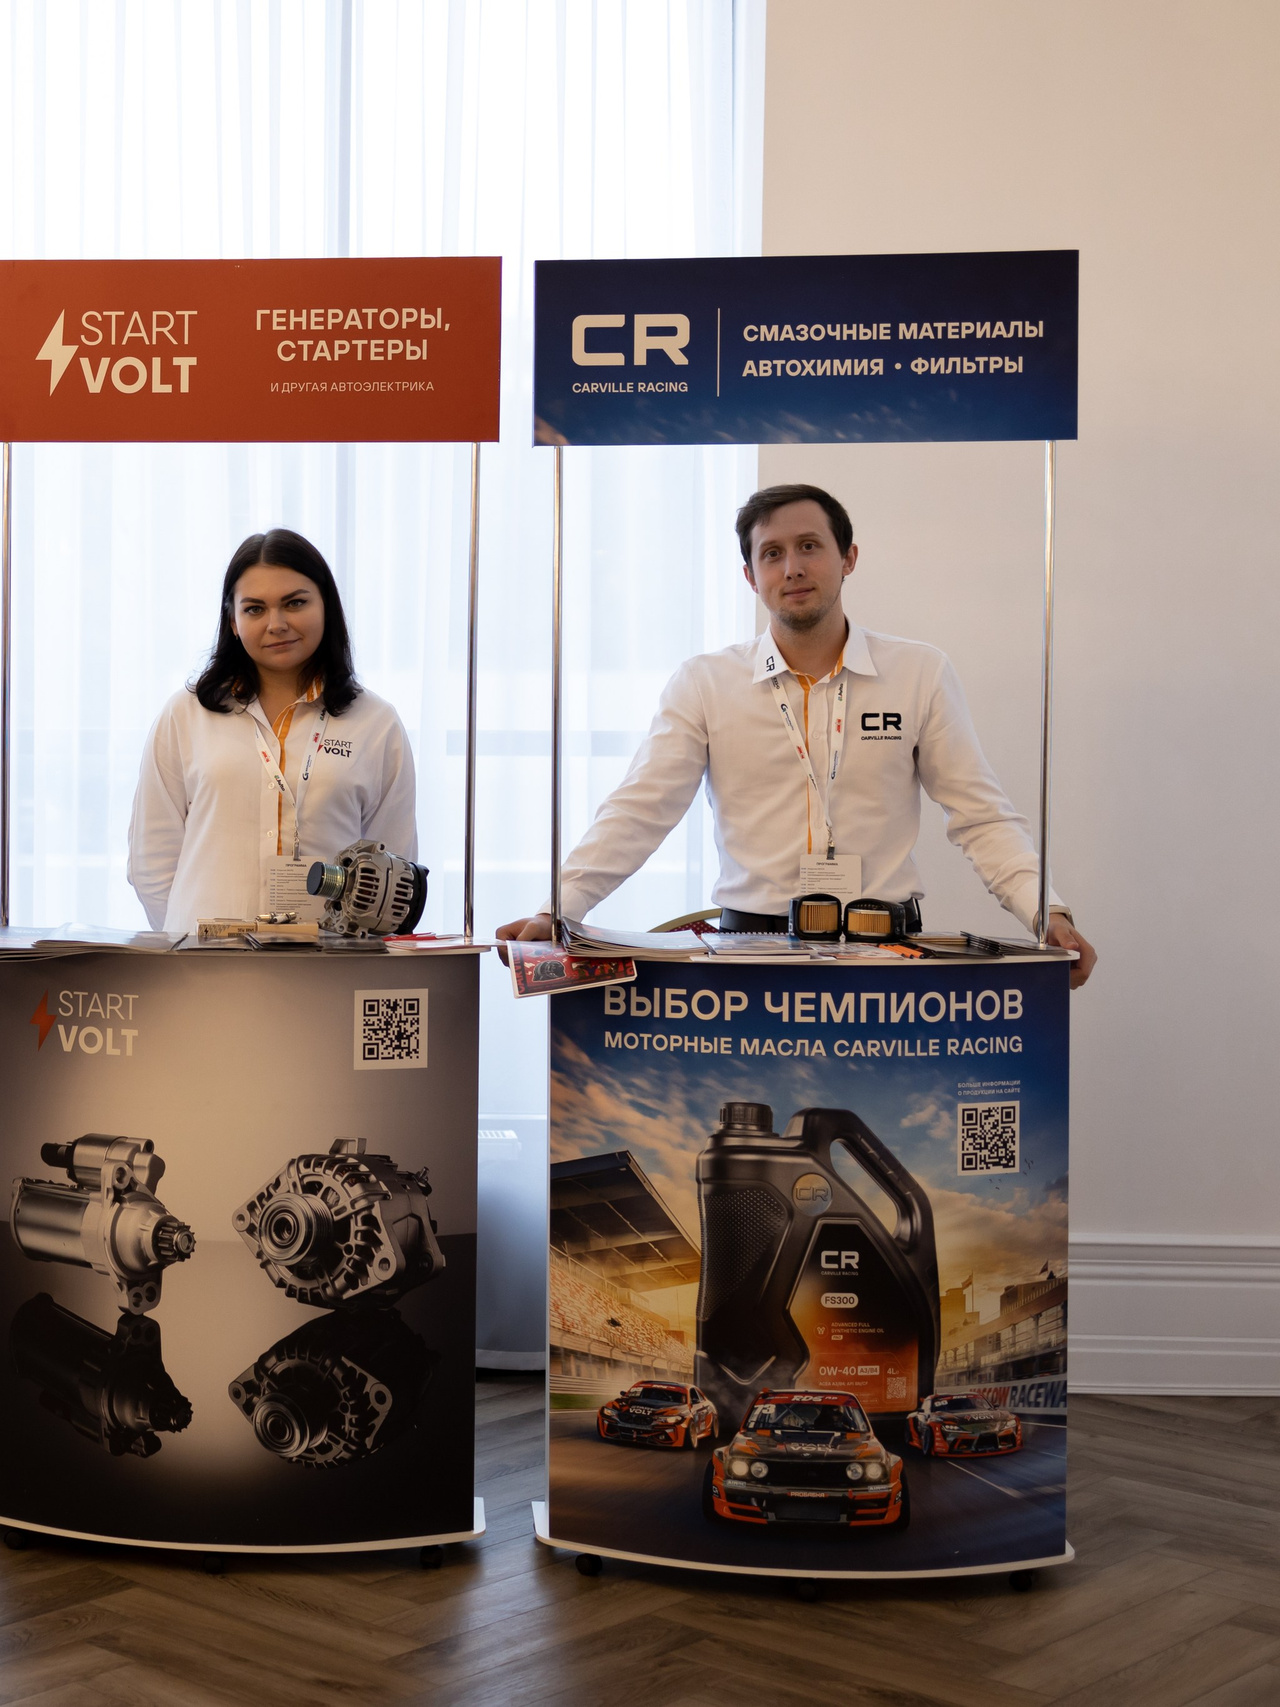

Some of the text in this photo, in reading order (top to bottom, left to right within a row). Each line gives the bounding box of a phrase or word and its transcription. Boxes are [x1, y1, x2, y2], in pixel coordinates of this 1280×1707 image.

[79, 310, 199, 346] START
[255, 307, 451, 332] ГЕНЕРАТОРЫ,
[571, 313, 691, 367] CR
[743, 320, 1044, 342] СМАЗОЧНЫЕ МАТЕРИАЛЫ
[276, 339, 429, 362] СТАРТЕРЫ
[78, 356, 198, 394] VOLT
[742, 356, 1024, 377] АВТОХИМИЯ ФИЛЬТРЫ
[270, 381, 435, 395] И ДРУГАЯ АВТОЭЛЕКТРИКА
[572, 381, 689, 394] CARVILLE RACING
[860, 712, 903, 732] CR
[323, 746, 353, 758] VOLT
[324, 738, 354, 749] START
[57, 990, 140, 1021] START
[603, 984, 1025, 1024] ВЫБОР ЧЕМПИОНОВ
[57, 1024, 139, 1057] VOLT
[604, 1031, 1024, 1058] МОТОРНЫЕ МАСЛА CARVILLE RACING
[957, 1080, 1021, 1089] БОЛЬШЕ ИНФОРМАЦИИ
[963, 1089, 996, 1097] ПРОДУКЦИИ
[1003, 1086, 1021, 1094] САЙТЕ
[820, 1250, 860, 1269] CR
[824, 1296, 855, 1305] FS300
[819, 1366, 857, 1376] 0W-40
[970, 1386, 1011, 1408] SCOW
[629, 1408, 653, 1416] VOLT
